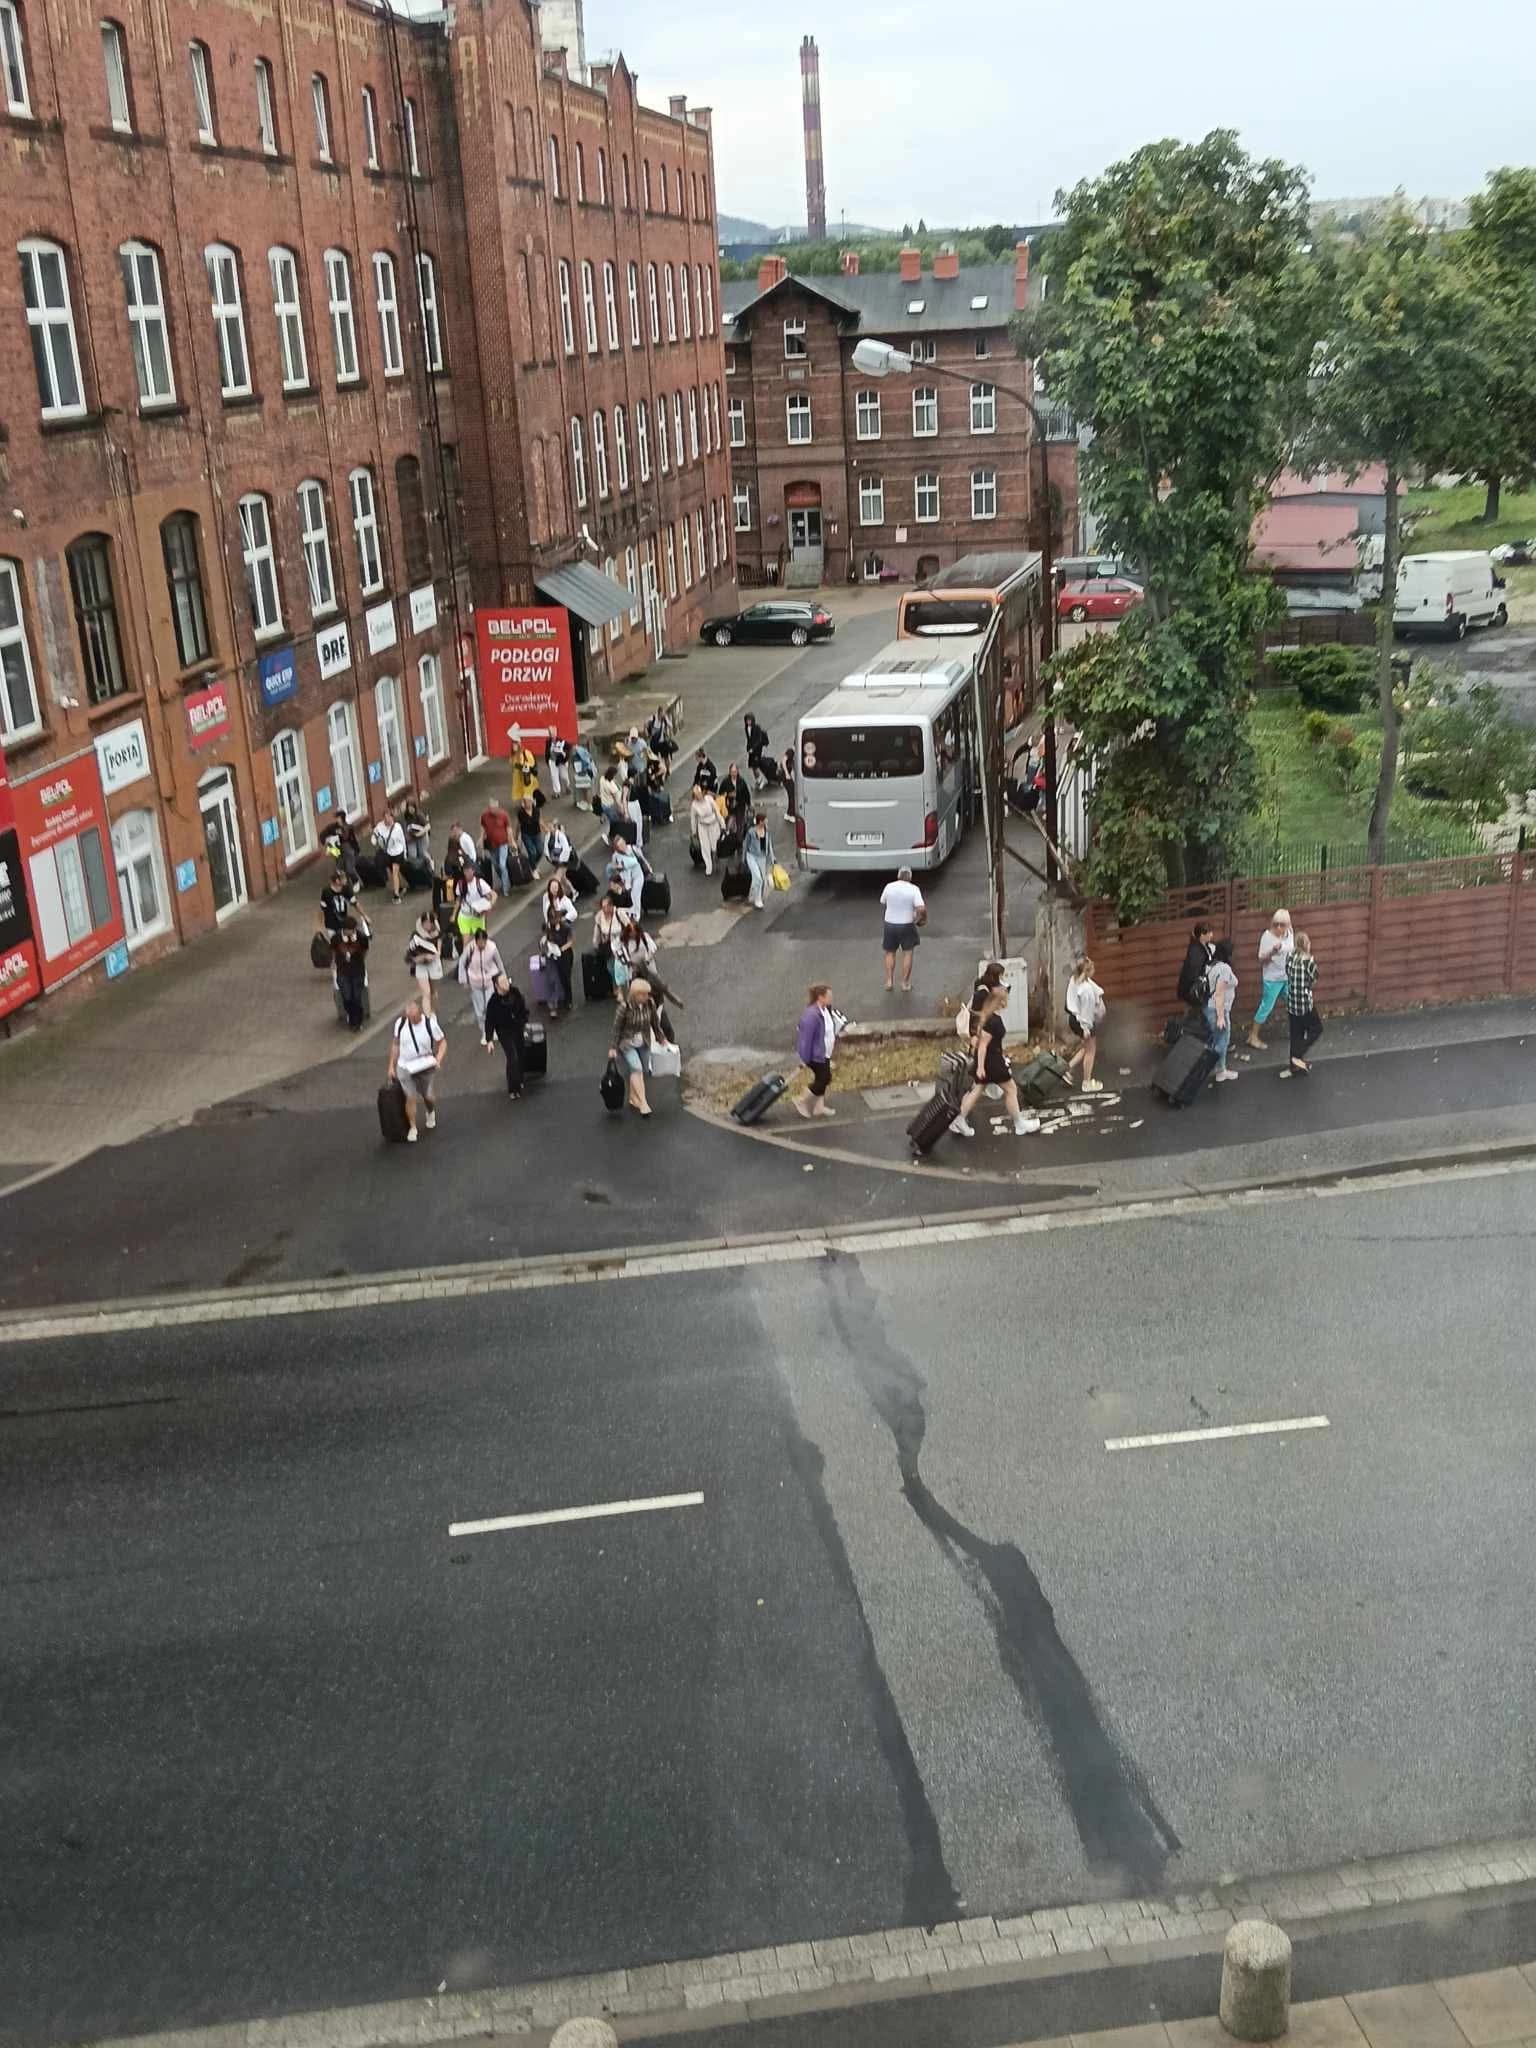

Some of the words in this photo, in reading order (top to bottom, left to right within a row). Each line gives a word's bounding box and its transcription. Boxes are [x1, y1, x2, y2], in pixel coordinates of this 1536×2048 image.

[322, 636, 345, 663] DRE
[490, 647, 560, 663] PODŁOGI
[501, 667, 552, 683] DRZWI
[109, 743, 139, 769] PORTA
